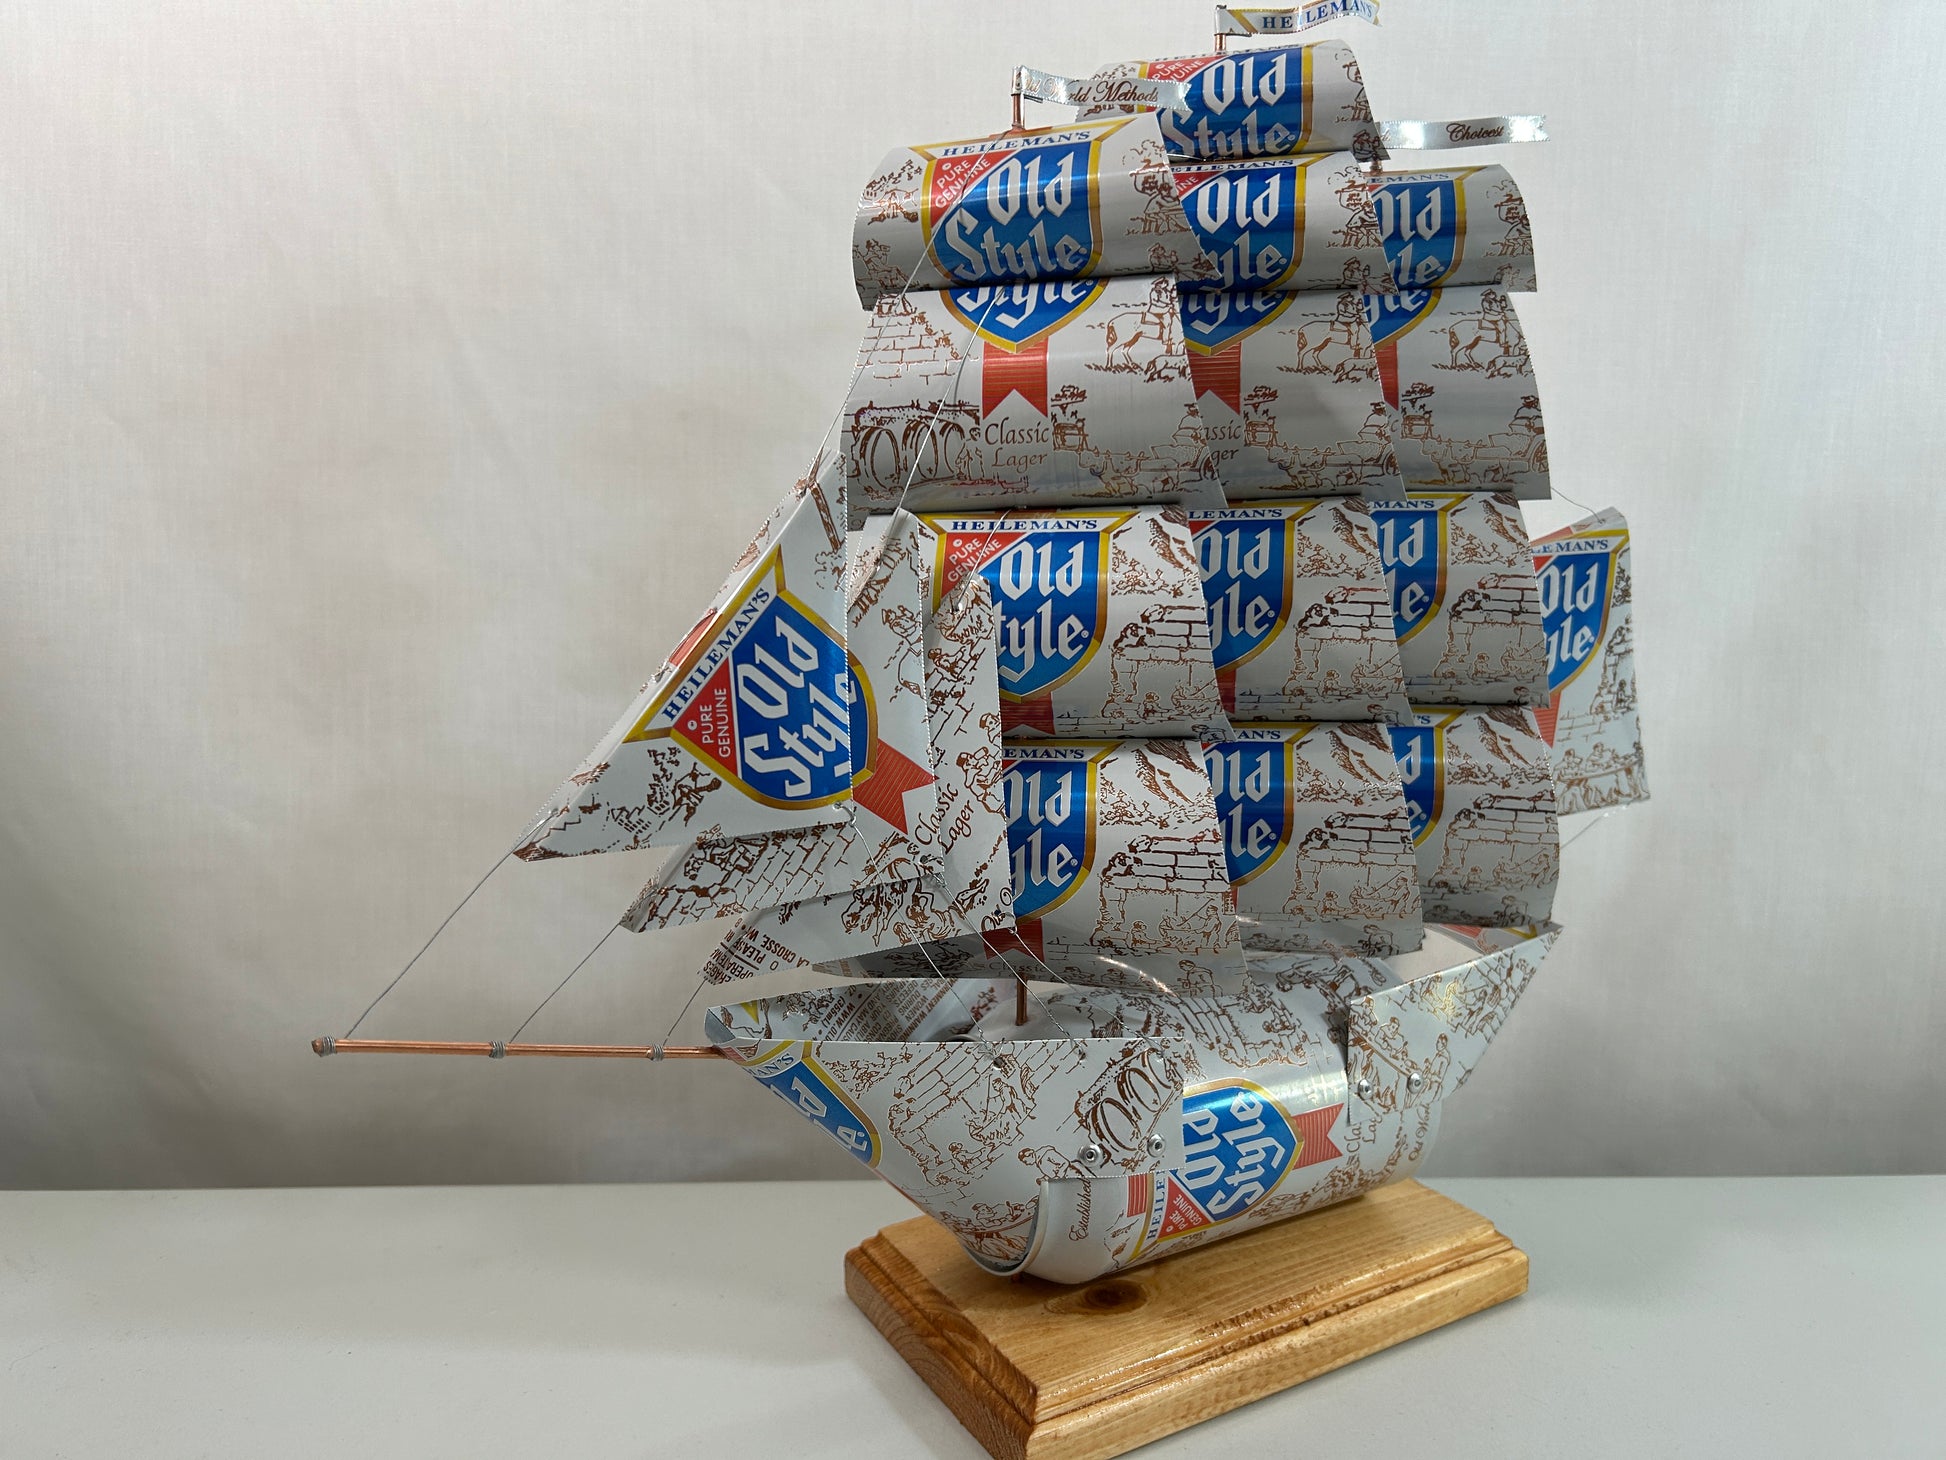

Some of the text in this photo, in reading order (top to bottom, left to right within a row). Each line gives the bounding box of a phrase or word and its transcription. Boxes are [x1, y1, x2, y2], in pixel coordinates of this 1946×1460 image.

[1262, 0, 1374, 29] HELEMAN'S
[1092, 79, 1159, 104] Methods
[1202, 53, 1287, 115] Old
[942, 130, 1092, 157] HEILEMAN'S
[1445, 122, 1505, 143] Choicest
[935, 158, 991, 209] GENUINE
[936, 160, 972, 189] PURE
[987, 151, 1075, 226] Old
[1196, 173, 1281, 234] Old
[945, 205, 1084, 281] Style
[984, 420, 1050, 446] Classic
[990, 449, 1049, 476] Lager
[951, 519, 1099, 531] HEILEMAN'S
[948, 537, 982, 566] PURE
[1193, 527, 1271, 583] Old
[999, 541, 1085, 601] Old
[1536, 562, 1599, 619] Old
[661, 586, 771, 722] HEILEMAN'S
[737, 615, 820, 719] Old
[702, 704, 714, 745] PURE
[718, 687, 730, 758] GENUINE
[915, 783, 959, 846] Classic
[937, 800, 974, 855] Lager
[761, 934, 797, 964] CROSSE,
[821, 996, 846, 1028] (355mL)
[856, 1008, 870, 1027] MAY
[866, 994, 882, 1010] AND
[870, 1003, 886, 1022] YOUR
[897, 990, 921, 1017] DURING
[1205, 1091, 1286, 1215] Style
[1068, 1177, 1092, 1242] Established
[1169, 1210, 1189, 1231] PURE
[1173, 1194, 1203, 1226] GENUINE
